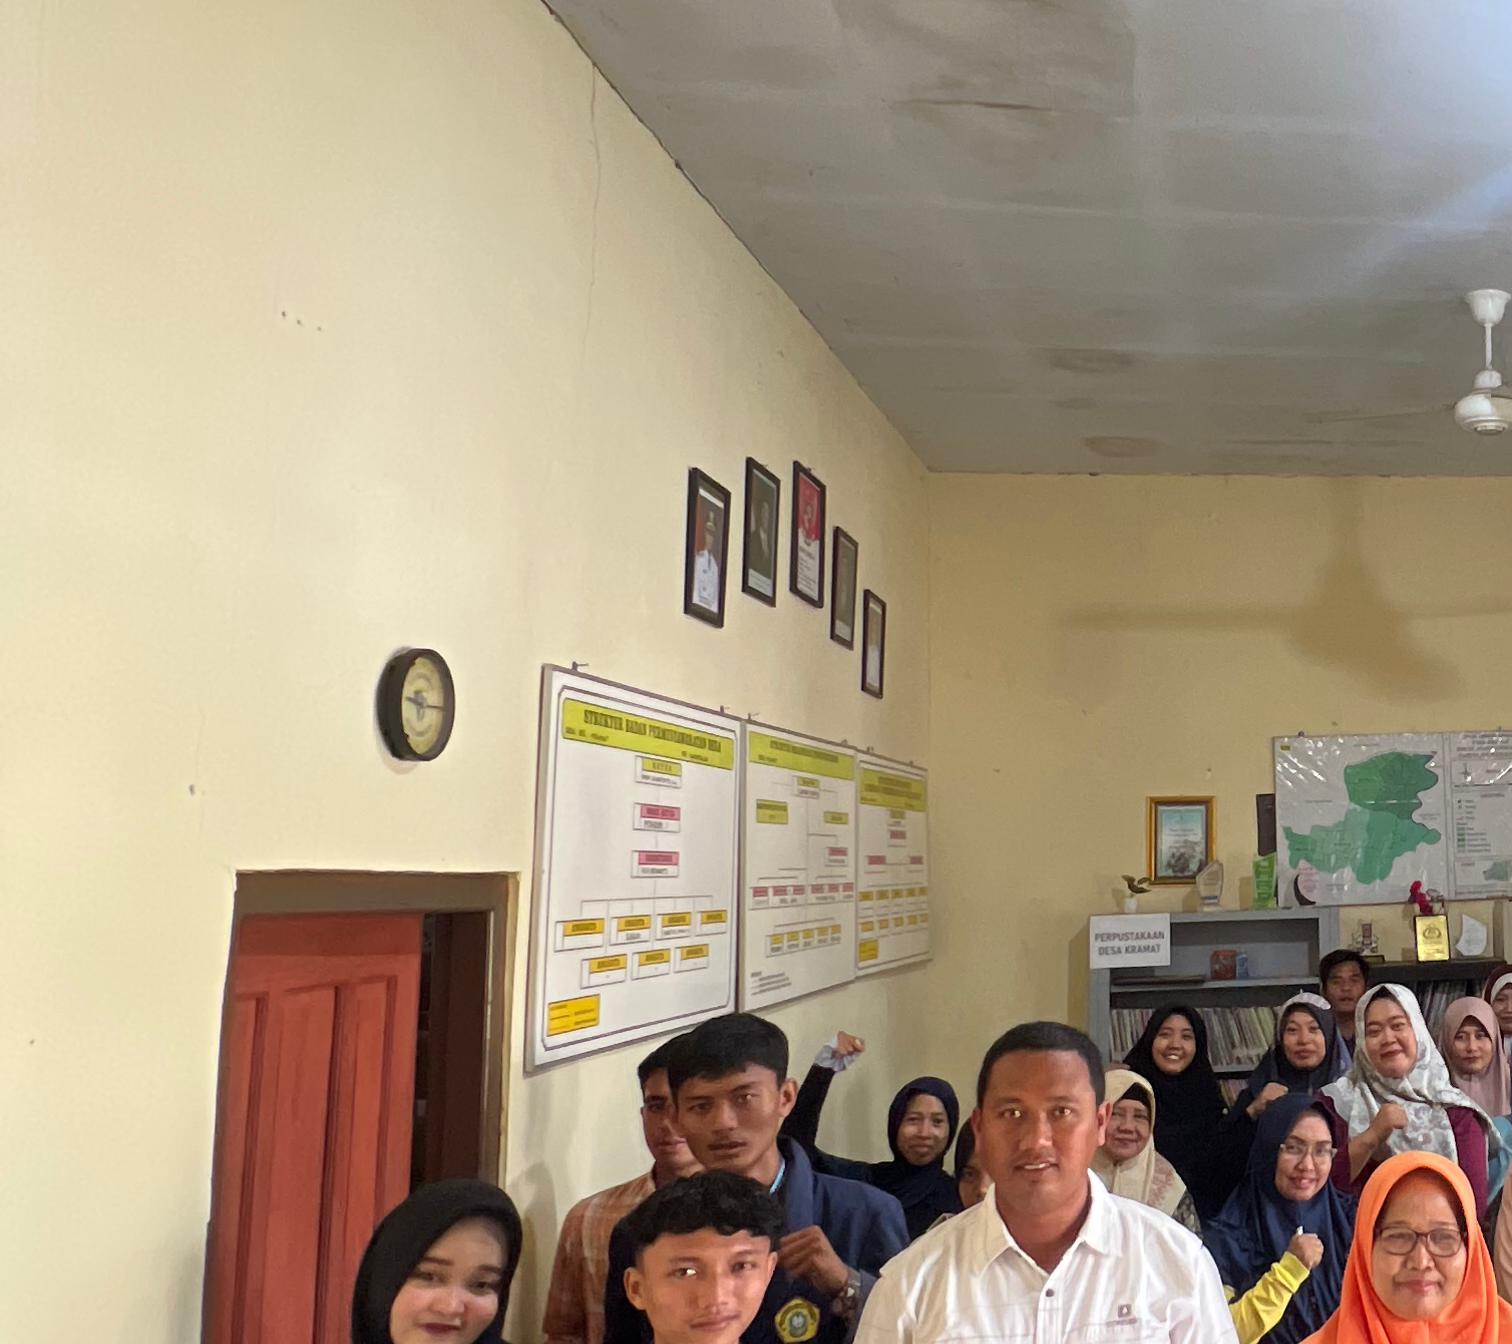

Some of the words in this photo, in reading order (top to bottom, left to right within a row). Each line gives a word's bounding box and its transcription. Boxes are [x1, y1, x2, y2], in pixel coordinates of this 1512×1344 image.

[1095, 931, 1165, 942] PERPUSTAKAAN
[1098, 946, 1122, 956] DESA
[1124, 944, 1160, 954] KRAMAT
